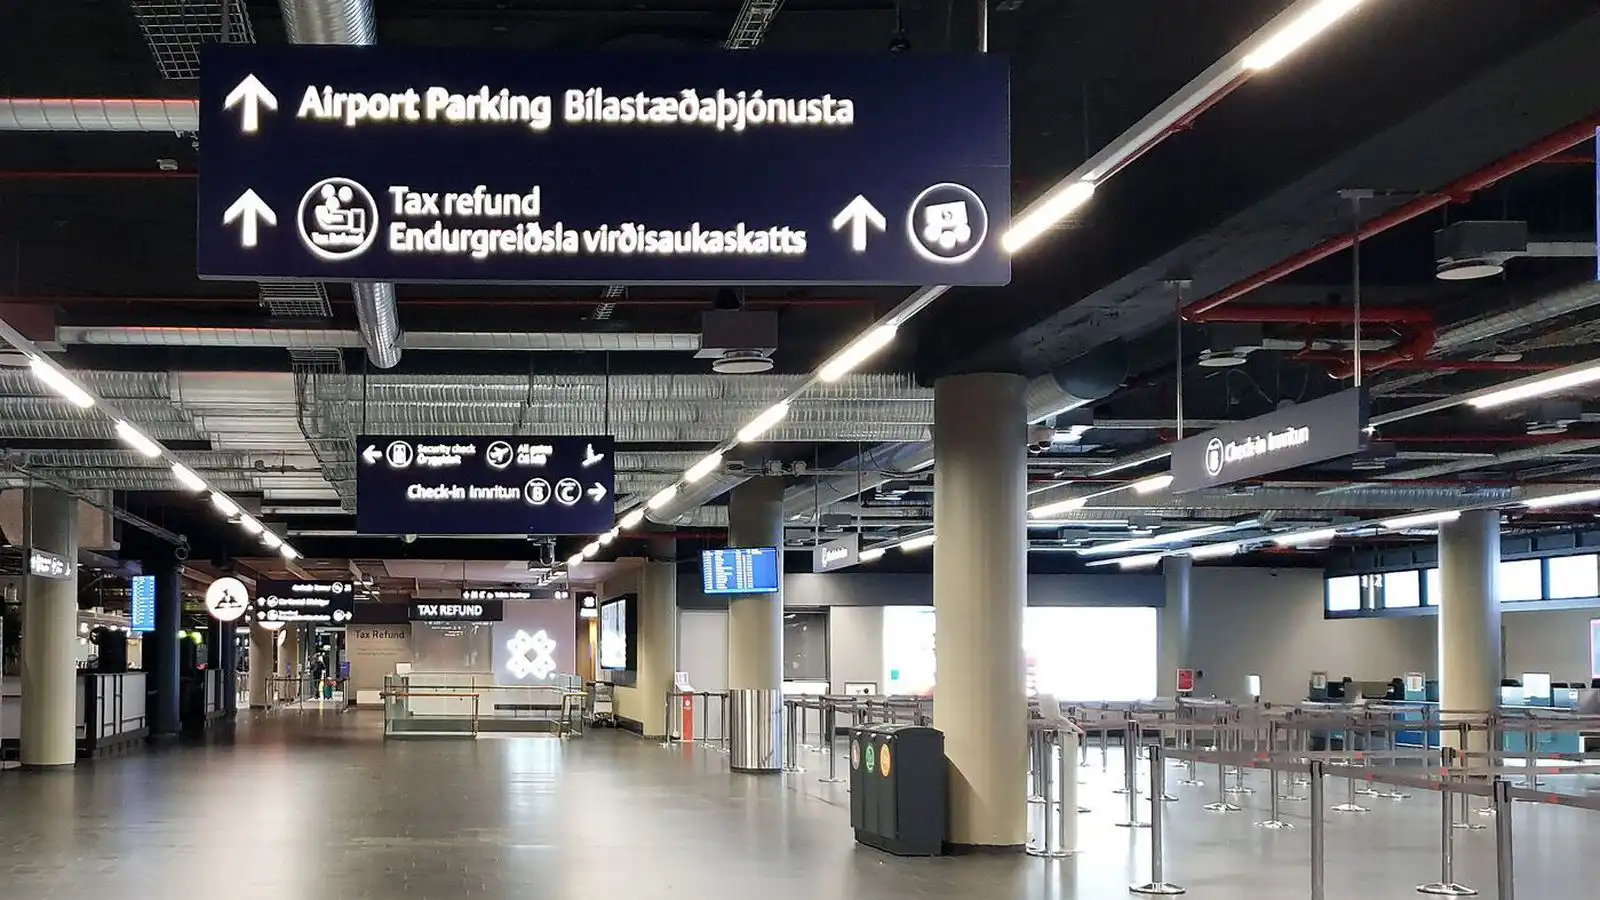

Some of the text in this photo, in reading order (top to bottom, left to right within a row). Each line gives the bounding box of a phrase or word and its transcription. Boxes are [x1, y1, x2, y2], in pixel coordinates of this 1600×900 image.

[297, 86, 854, 132] Airport Parking Bílastæðaþjónusta
[389, 185, 540, 216] Tax refund
[389, 222, 806, 258] Endurgreiðsla virðisaukaskatts
[407, 484, 520, 499] Check-in Innritun
[532, 486, 543, 500] B
[561, 486, 575, 500] C
[418, 605, 482, 616] TAX REFUND
[356, 630, 405, 639] Tax Refund
